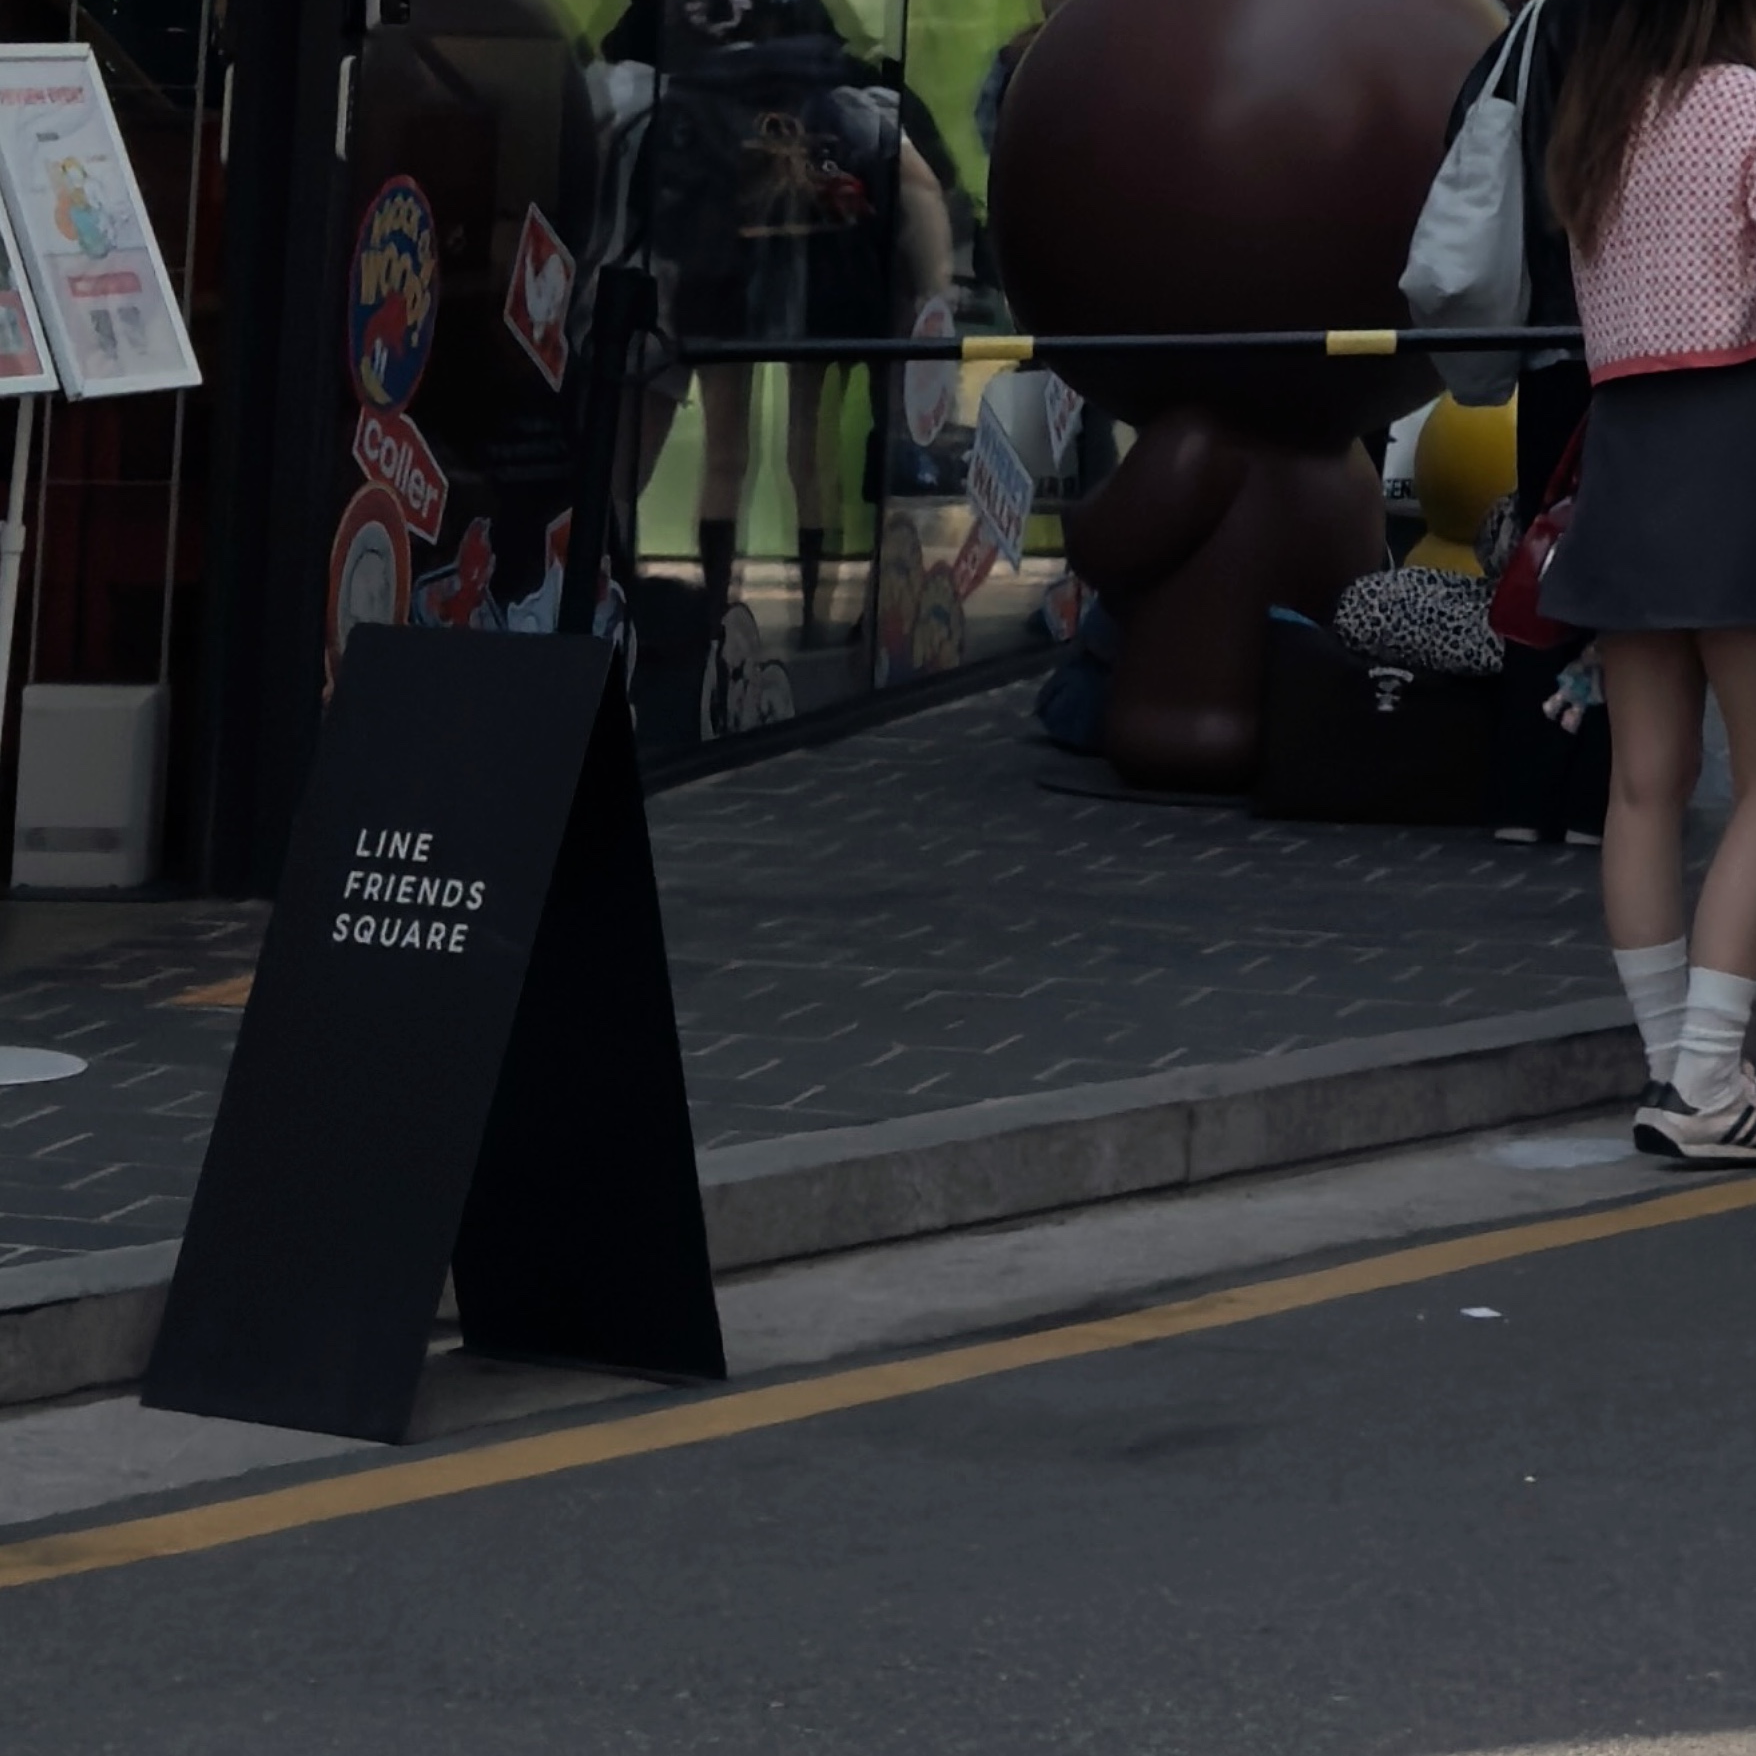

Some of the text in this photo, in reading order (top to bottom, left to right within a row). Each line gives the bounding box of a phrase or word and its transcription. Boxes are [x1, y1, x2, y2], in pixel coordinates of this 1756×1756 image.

[363, 418, 438, 520] Coller
[355, 827, 435, 863] LINE
[343, 870, 486, 911] FRIENDS
[332, 913, 468, 954] SQUARE
